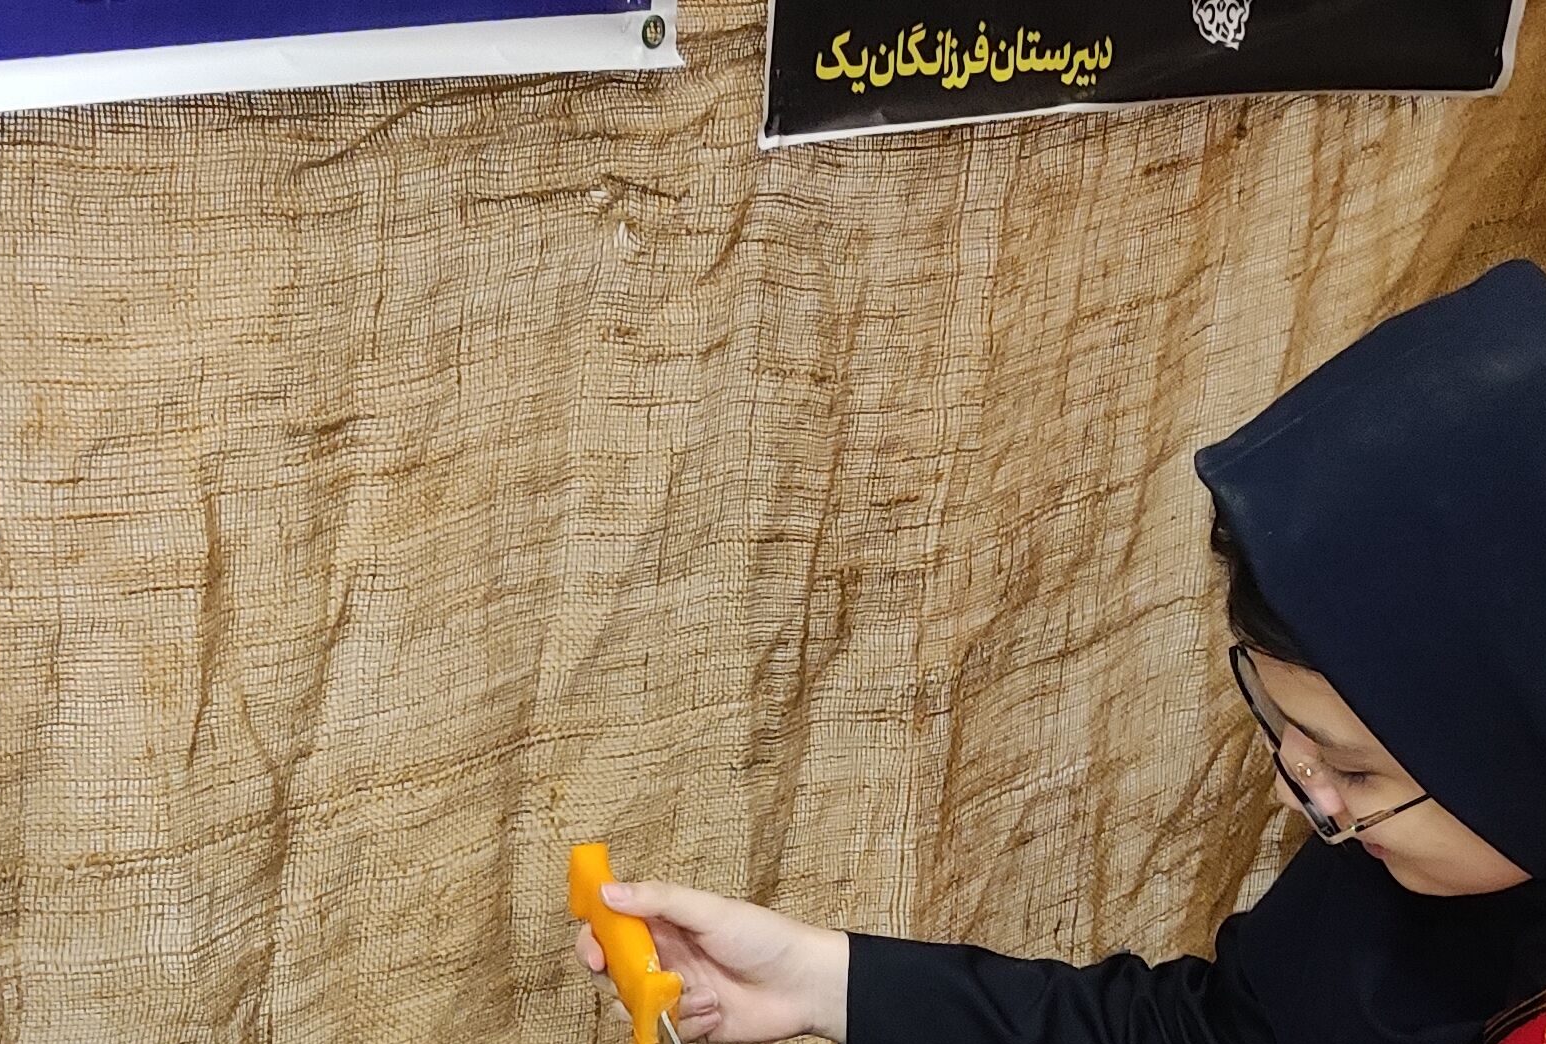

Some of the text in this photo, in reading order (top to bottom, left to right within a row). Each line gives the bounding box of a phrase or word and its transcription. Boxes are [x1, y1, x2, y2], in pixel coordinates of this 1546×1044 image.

[815, 20, 1113, 95] دبیرستان فرزانگان یک
